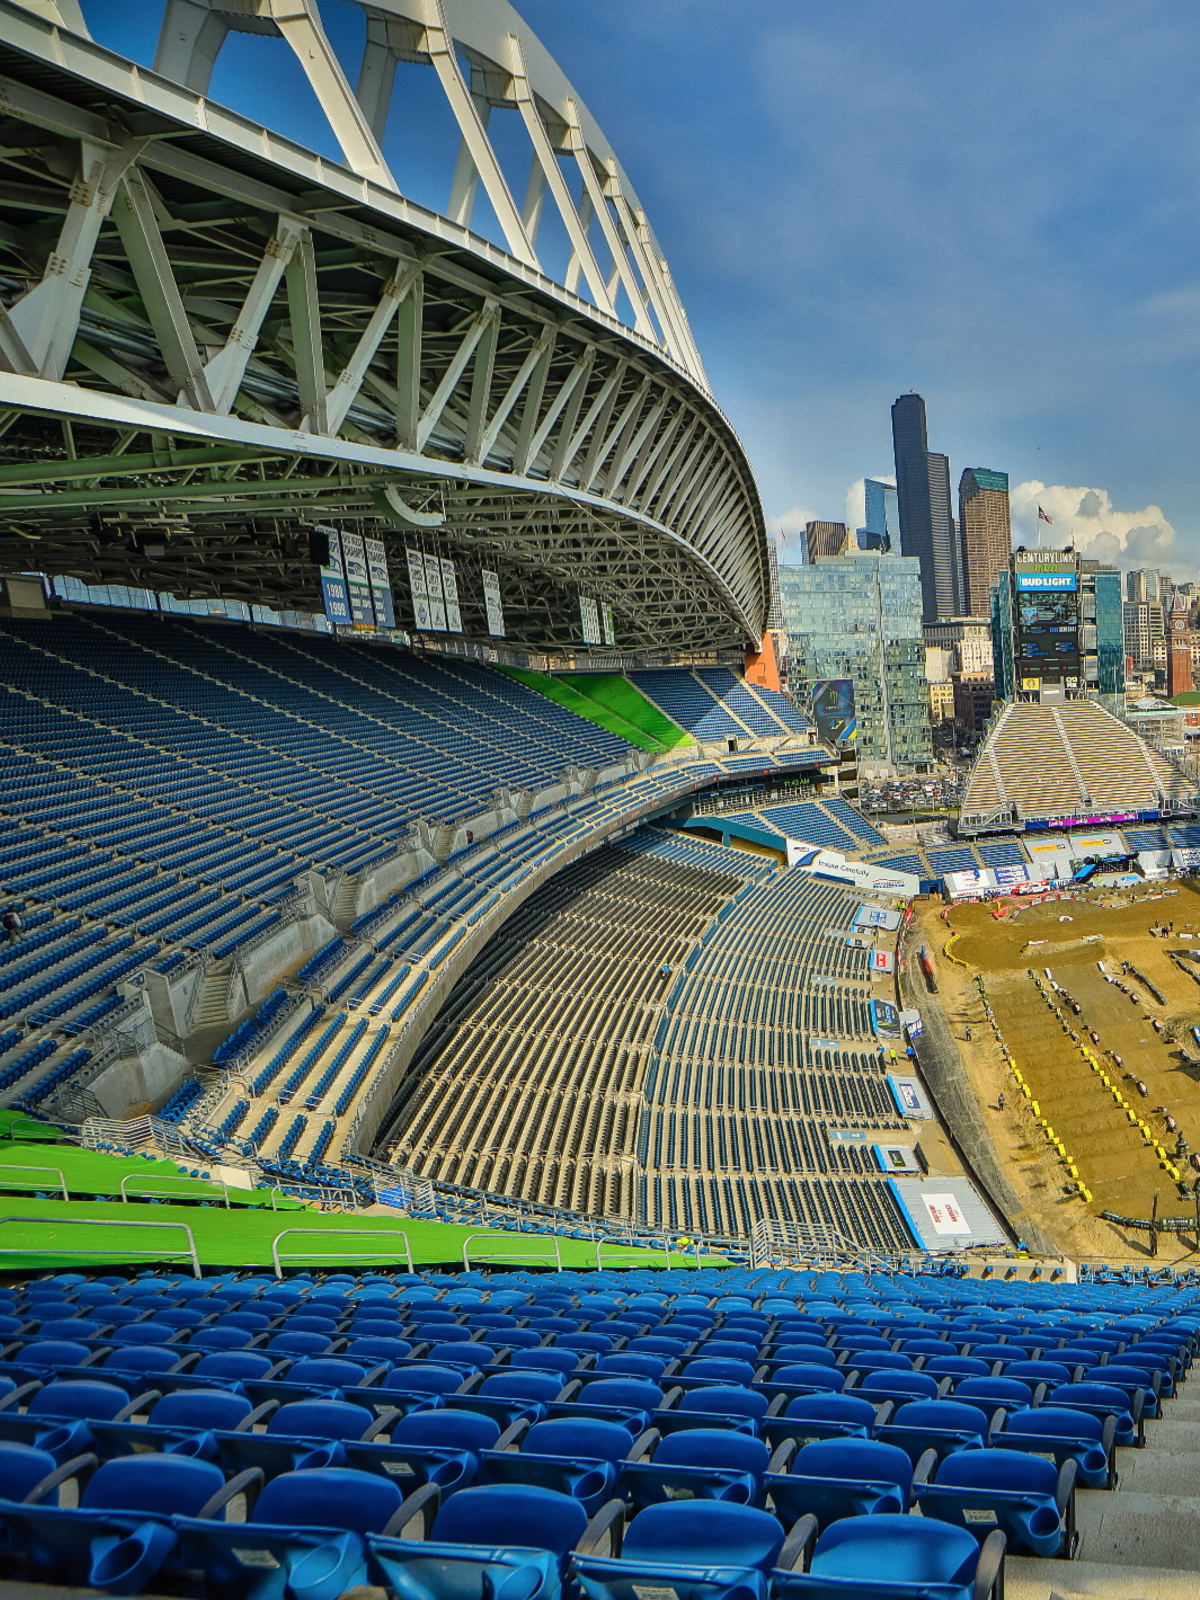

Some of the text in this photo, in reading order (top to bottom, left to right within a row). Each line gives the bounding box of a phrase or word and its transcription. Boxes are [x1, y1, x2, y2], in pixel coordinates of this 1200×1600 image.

[1017, 552, 1074, 563] CENTURYLINK
[1034, 564, 1058, 572] FIELD
[1022, 577, 1072, 586] BUD LIGHT
